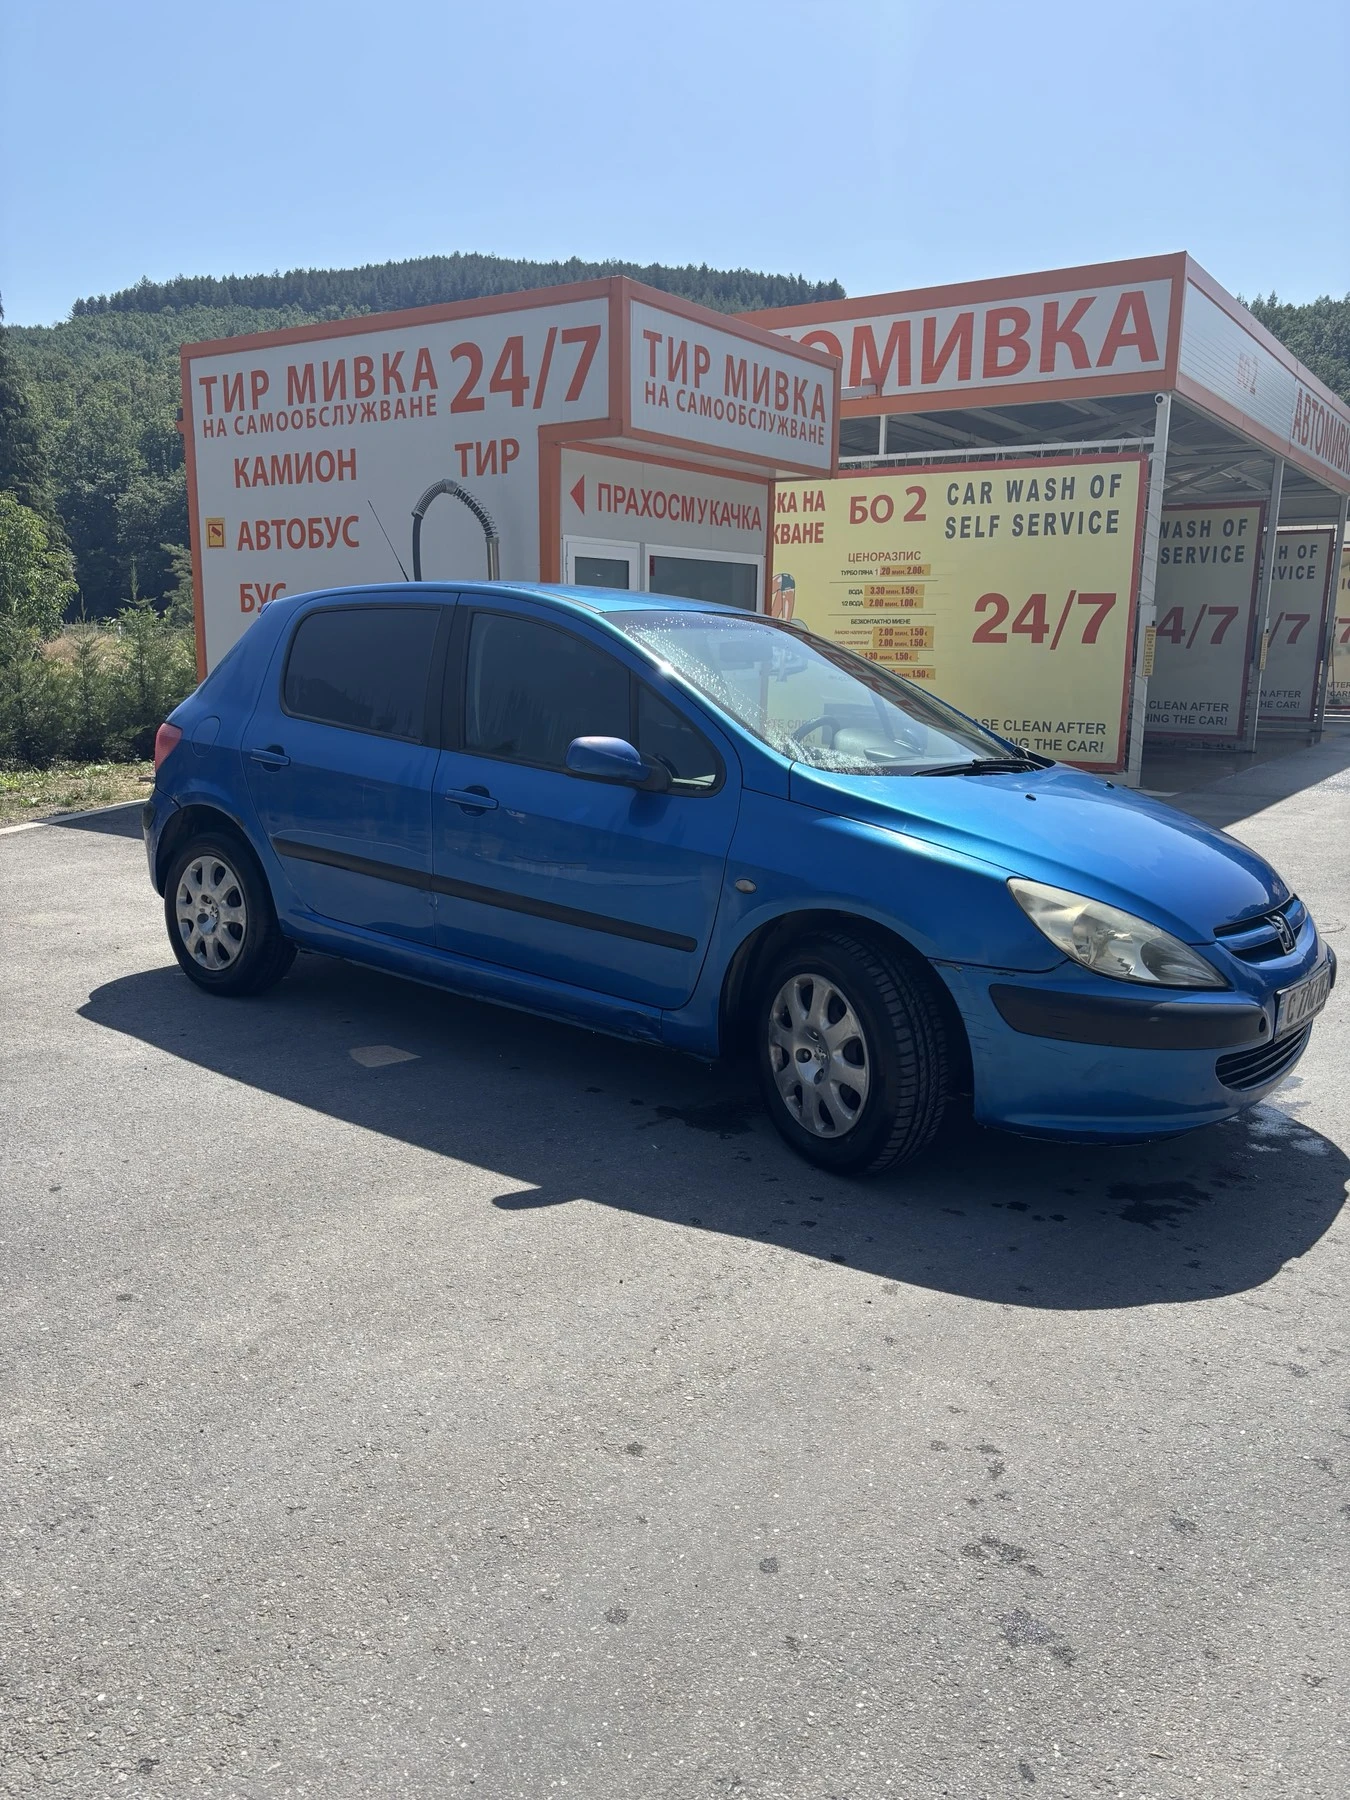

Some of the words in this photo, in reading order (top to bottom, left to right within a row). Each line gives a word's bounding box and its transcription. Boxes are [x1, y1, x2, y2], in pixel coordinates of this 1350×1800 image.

[785, 291, 1160, 390] МИВКА
[199, 369, 270, 415] ТИР
[287, 347, 438, 407] МИВКА
[450, 324, 601, 414] 24/7
[643, 329, 711, 389] ТИР
[724, 354, 826, 423] МИВКА
[203, 417, 228, 438] НА
[234, 394, 437, 436] САМООБСЛУЖВАНЕ
[644, 381, 669, 408] НА
[676, 389, 825, 446] САМООБСЛУЖВАНЕ
[1292, 387, 1350, 475] АВТОМИВК
[234, 448, 357, 489] КАМИОН
[454, 437, 520, 478] ТИР
[598, 482, 762, 531] ПРАХОСМУКАЧКА
[775, 491, 798, 513] КА
[803, 490, 826, 512] НА
[850, 495, 894, 525] БО
[903, 486, 927, 522] 2
[947, 481, 992, 506] CAR
[1006, 476, 1076, 503] WASH
[1090, 474, 1122, 499] OF
[237, 515, 360, 551] АВТОБУС
[945, 515, 1000, 539] SELF
[1012, 510, 1119, 537] SERVICE
[1223, 519, 1248, 537] OF
[848, 551, 921, 563] ЦЕНОРАЗПИС
[1160, 545, 1245, 564] SERVICE
[1297, 544, 1318, 559] OF
[972, 590, 1117, 650] 24/7
[1156, 604, 1239, 649] 4/7
[1149, 700, 1187, 710] CLEAN
[1190, 702, 1229, 712] AFTER
[1269, 690, 1301, 698] AFTER
[1003, 719, 1052, 732] CLEAN
[1055, 721, 1106, 735] AFTER
[1173, 714, 1195, 724] THE
[1199, 715, 1228, 726] CAR!
[1034, 738, 1062, 751] THE
[1067, 740, 1104, 753] CAR!
